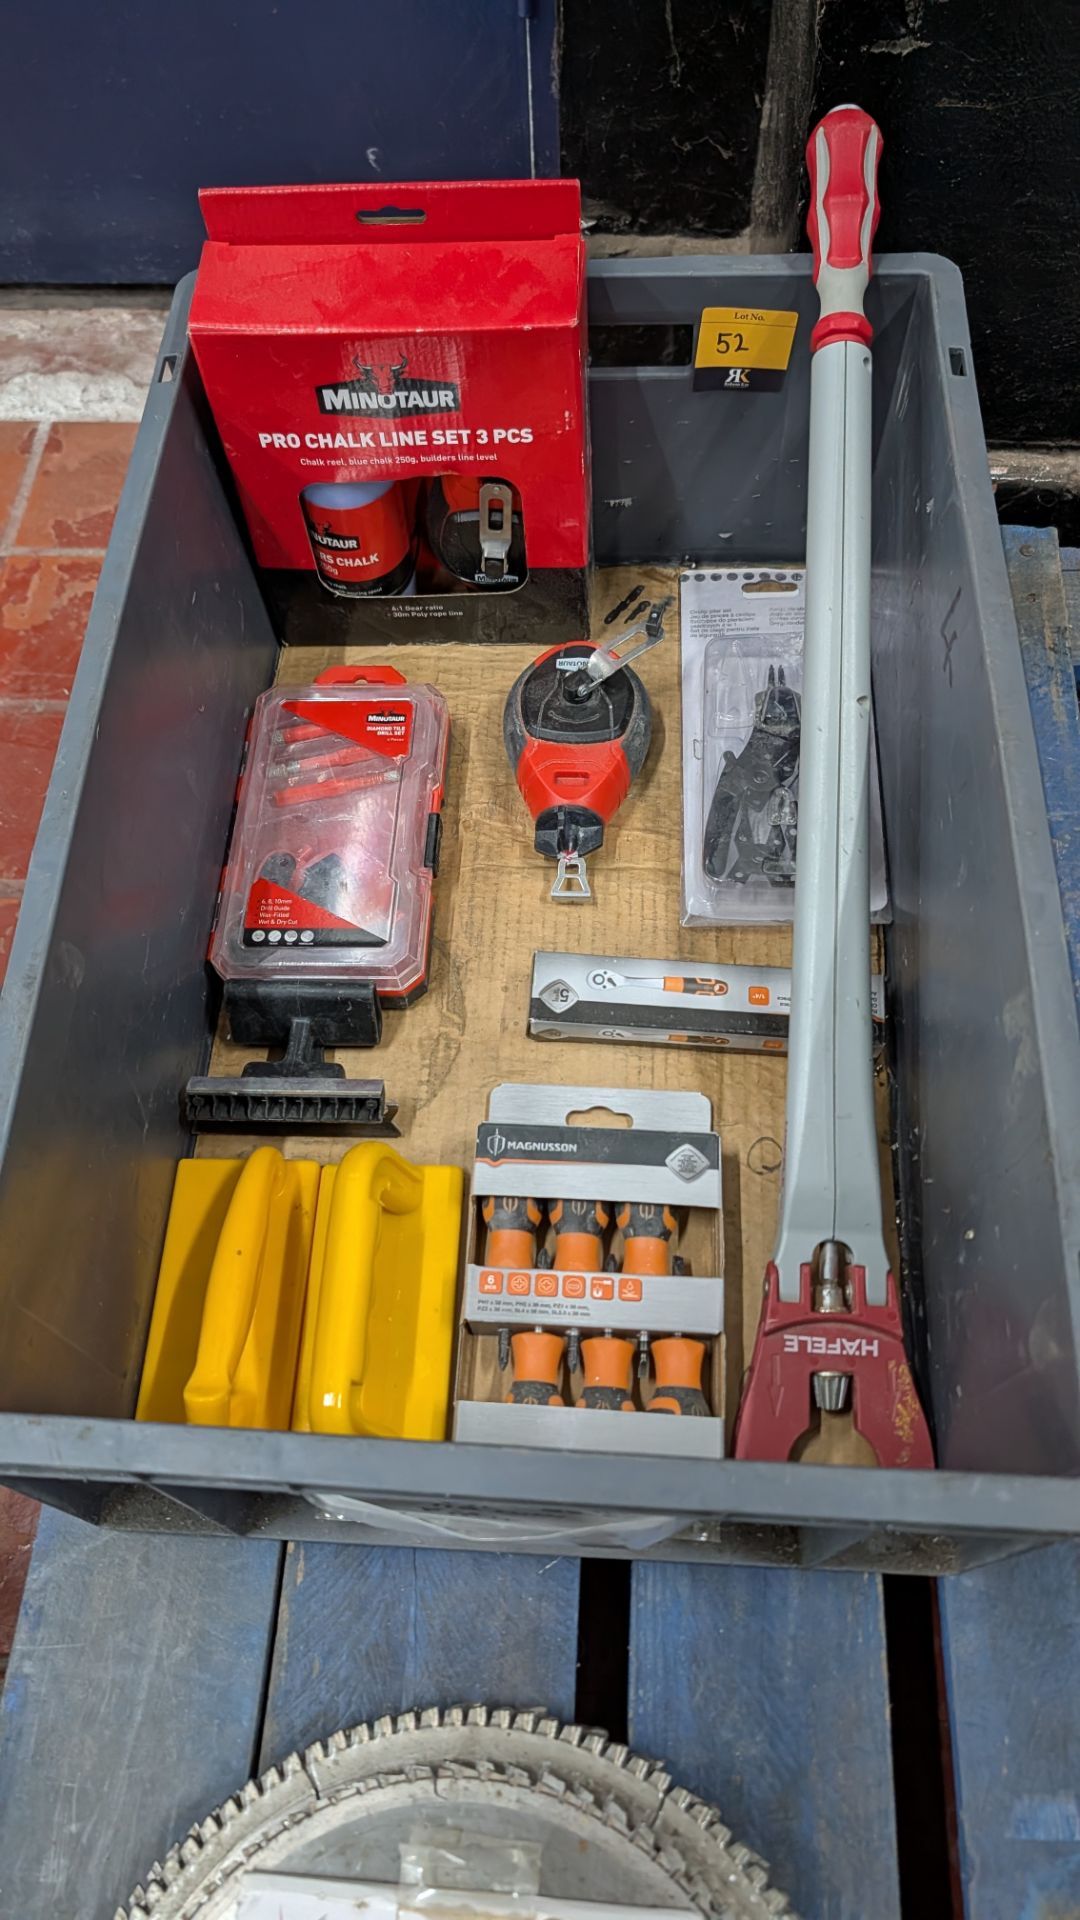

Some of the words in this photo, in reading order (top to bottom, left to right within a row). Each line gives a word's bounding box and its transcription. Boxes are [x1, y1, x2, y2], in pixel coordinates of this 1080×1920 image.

[734, 312, 749, 320] Lot
[750, 313, 765, 321] No.
[716, 332, 750, 354] 52
[322, 388, 455, 410] MINOTAUR
[258, 433, 301, 449] PRO
[305, 432, 377, 448] CHALK
[379, 430, 428, 447] LINE
[432, 429, 470, 445] SET
[476, 429, 488, 444] 3
[493, 428, 533, 444] PCS
[300, 458, 325, 466] Chalk
[348, 457, 368, 465] blue
[370, 456, 393, 465] chalk
[420, 454, 456, 463] builders
[458, 453, 474, 461] line
[476, 453, 497, 461] level
[336, 553, 379, 568] CHALK
[560, 988, 570, 1002] 5
[507, 1140, 578, 1152] MAGNUSSON
[487, 1274, 495, 1285] 6
[783, 1334, 878, 1357] HÄFELE
